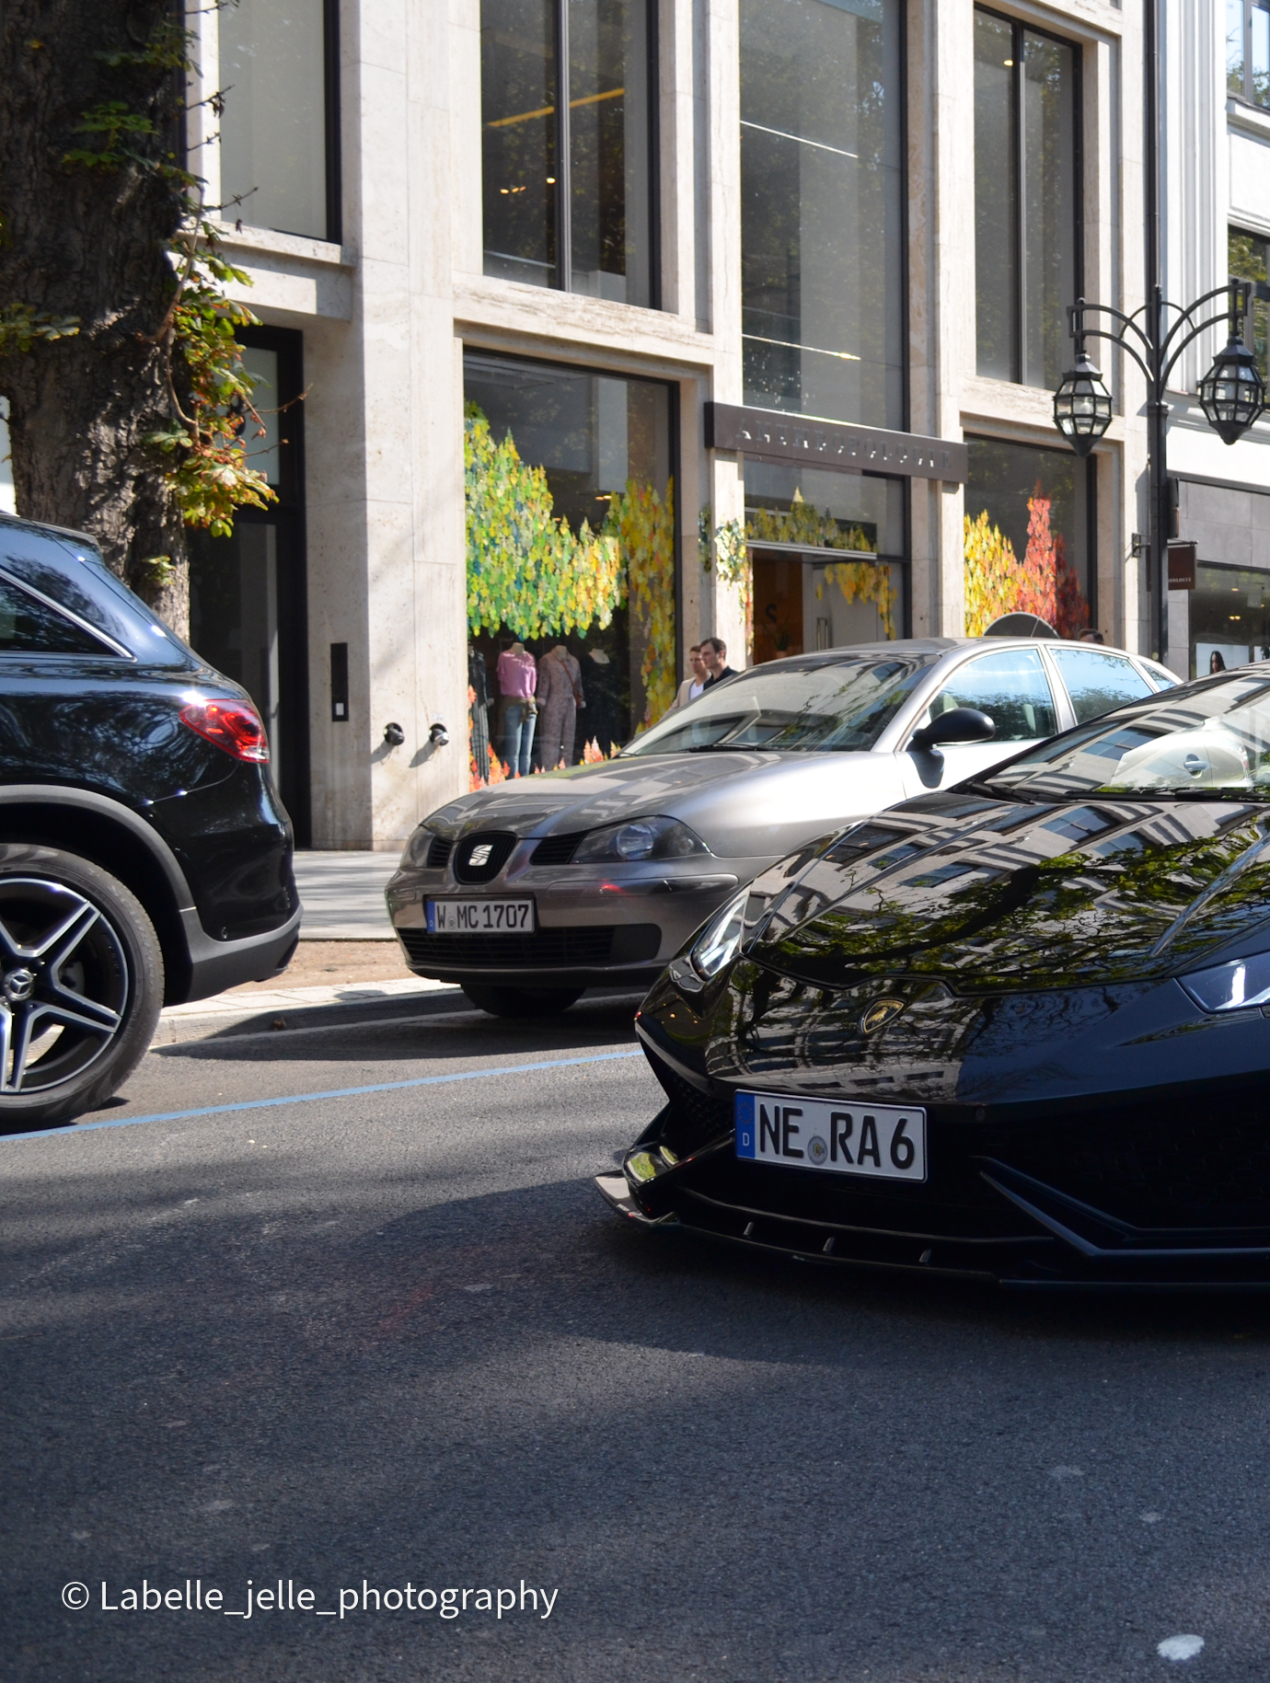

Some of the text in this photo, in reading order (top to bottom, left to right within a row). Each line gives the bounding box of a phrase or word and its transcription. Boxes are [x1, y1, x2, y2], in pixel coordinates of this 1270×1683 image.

[437, 905, 446, 928] W
[457, 904, 480, 929] MC
[482, 904, 529, 928] 1707
[742, 1103, 915, 1170] D NE RA 6
